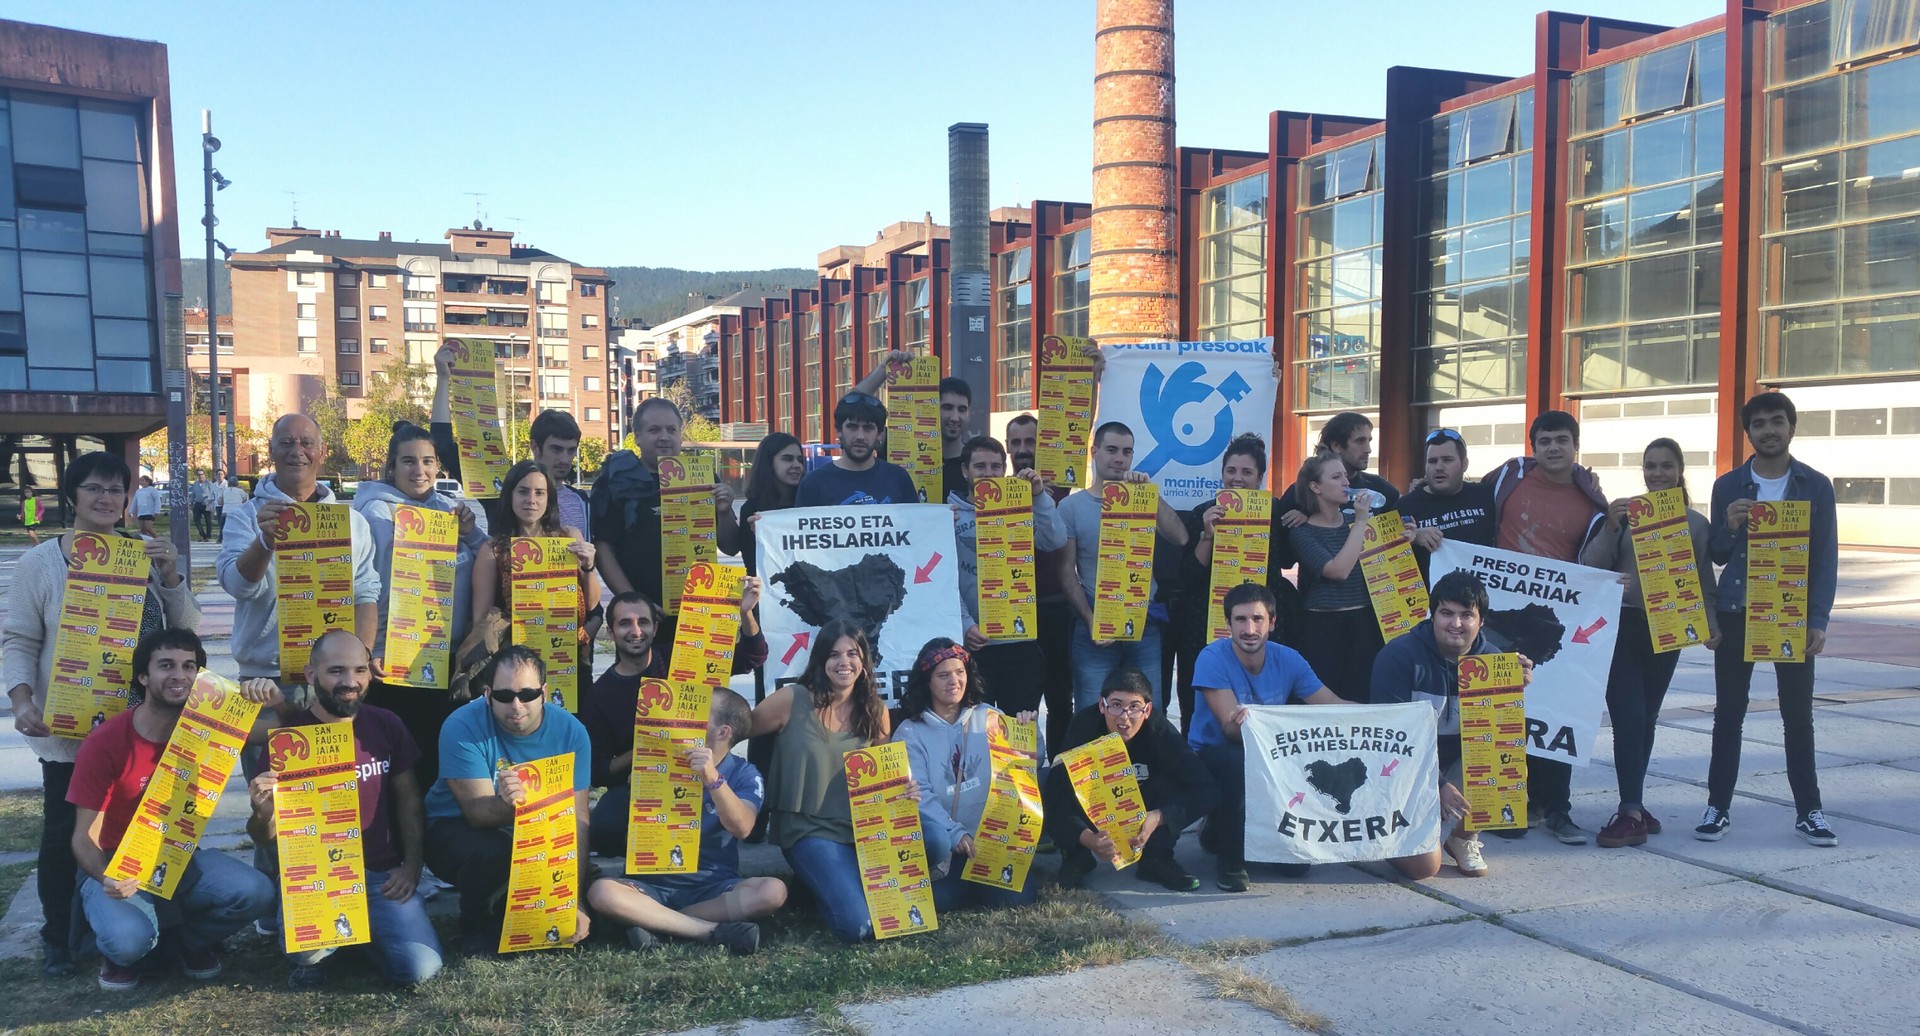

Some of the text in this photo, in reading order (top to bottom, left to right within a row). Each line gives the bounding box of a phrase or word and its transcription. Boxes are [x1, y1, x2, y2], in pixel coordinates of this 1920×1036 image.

[1178, 341, 1268, 356] presoak
[1134, 491, 1155, 499] FAUSTO
[1164, 489, 1190, 498] urriak
[1192, 490, 1203, 498] 20
[1133, 498, 1148, 506] JAIAK
[1247, 498, 1268, 506] FAUSTO
[1657, 496, 1680, 505] FAUSTO
[316, 513, 345, 522] FAUSTO
[798, 515, 894, 530] PRESO ETA
[1418, 508, 1485, 529] THE WILSONS
[316, 522, 338, 530] JAIAK
[430, 521, 454, 530] FAUSTO
[316, 530, 337, 538] 2018
[429, 528, 447, 536] JAIAK
[428, 535, 446, 543] 2018
[782, 531, 911, 551] IHESLARIAK
[118, 540, 134, 549] SAN
[116, 548, 147, 560] FAUSTO
[114, 558, 137, 568] JAIAK
[113, 566, 134, 575] 2018
[1472, 555, 1567, 585] PRESO ETA
[1493, 655, 1506, 663] SAN
[1494, 678, 1511, 686] 2018
[680, 684, 695, 692] SAN
[679, 693, 707, 704] FAUSTO
[230, 695, 256, 714] FAUSTO
[677, 702, 698, 711] JAIAK
[226, 704, 245, 719] JAIAK
[676, 710, 695, 719] 2018
[315, 726, 331, 736] SAN
[1275, 726, 1408, 746] EUSKAL PRESO
[316, 734, 348, 746] FAUSTO
[316, 745, 340, 756] JAIAK
[879, 747, 892, 755] SAN
[1270, 740, 1415, 761] ETA IHESLARIAK
[316, 755, 339, 765] 2018
[881, 752, 905, 763] FAUSTO
[546, 758, 558, 769] SAN
[882, 762, 900, 772] JAIAK
[546, 764, 570, 777] FAUSTO
[884, 770, 900, 779] 2018
[303, 781, 314, 792] 11
[344, 781, 356, 791] 19
[305, 825, 317, 835] 12
[1277, 809, 1410, 843] ETXERA
[347, 829, 359, 839] 20
[313, 881, 325, 891] 13
[352, 883, 364, 894] 21
